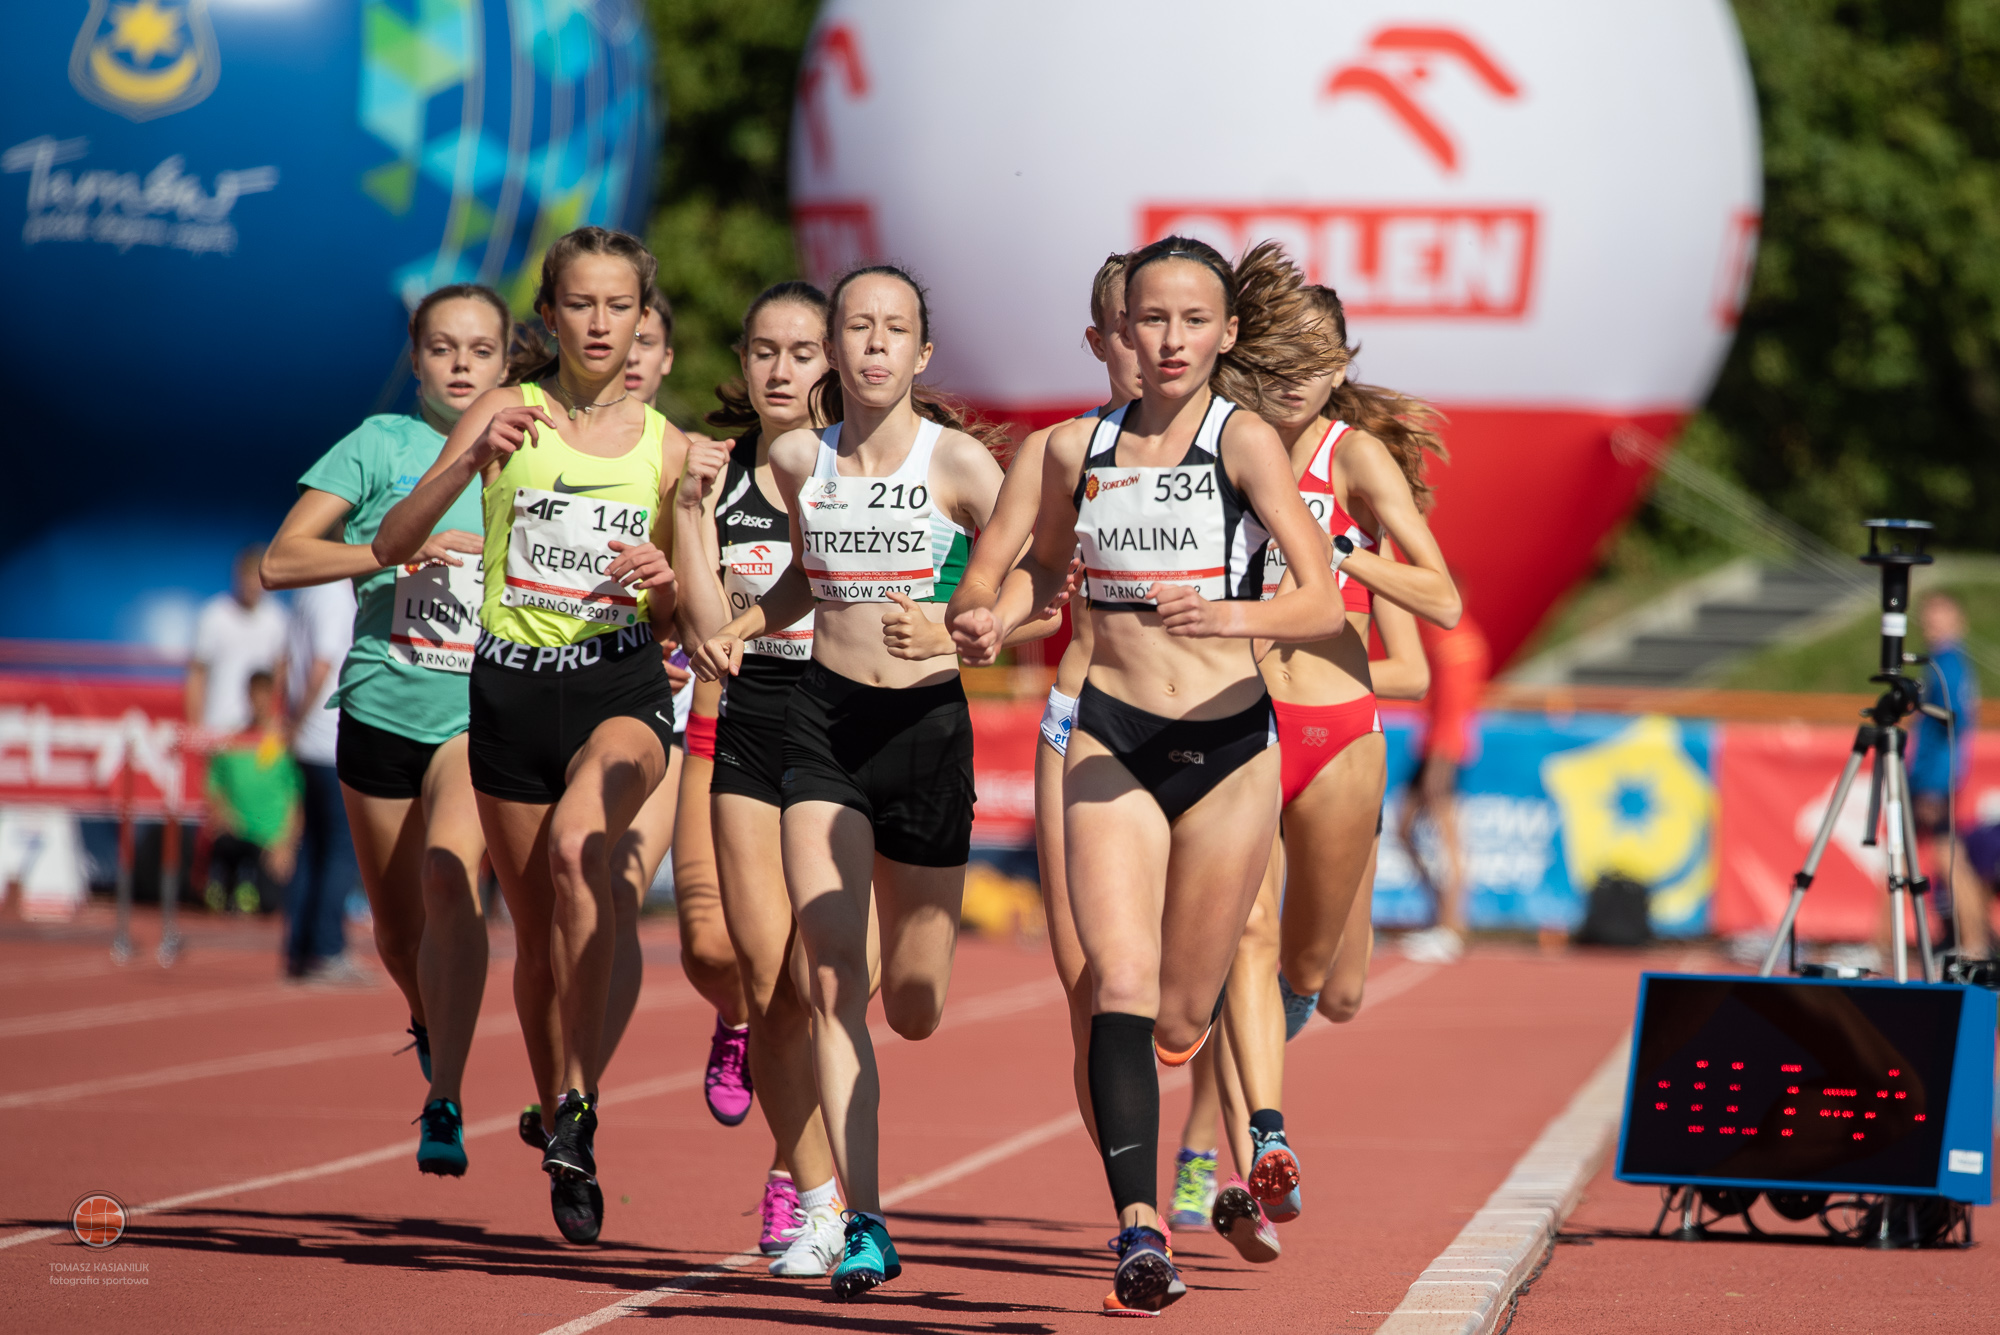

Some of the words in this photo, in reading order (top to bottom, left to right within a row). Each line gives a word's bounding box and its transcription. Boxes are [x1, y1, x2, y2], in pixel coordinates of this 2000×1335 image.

[867, 482, 928, 509] 210
[1154, 471, 1215, 502] 534
[592, 505, 645, 537] 148
[804, 525, 925, 554] STRZEŻYSZ
[1098, 527, 1198, 551] MALINA
[732, 563, 771, 574] ORLEN
[821, 582, 873, 598] TARNÓW
[521, 592, 583, 617] TARNÓW
[587, 606, 619, 621] 2019
[410, 650, 468, 668] TARNÓW
[532, 636, 602, 673] PRO
[754, 640, 806, 656] TARNÓW
[1168, 750, 1204, 765] esa
